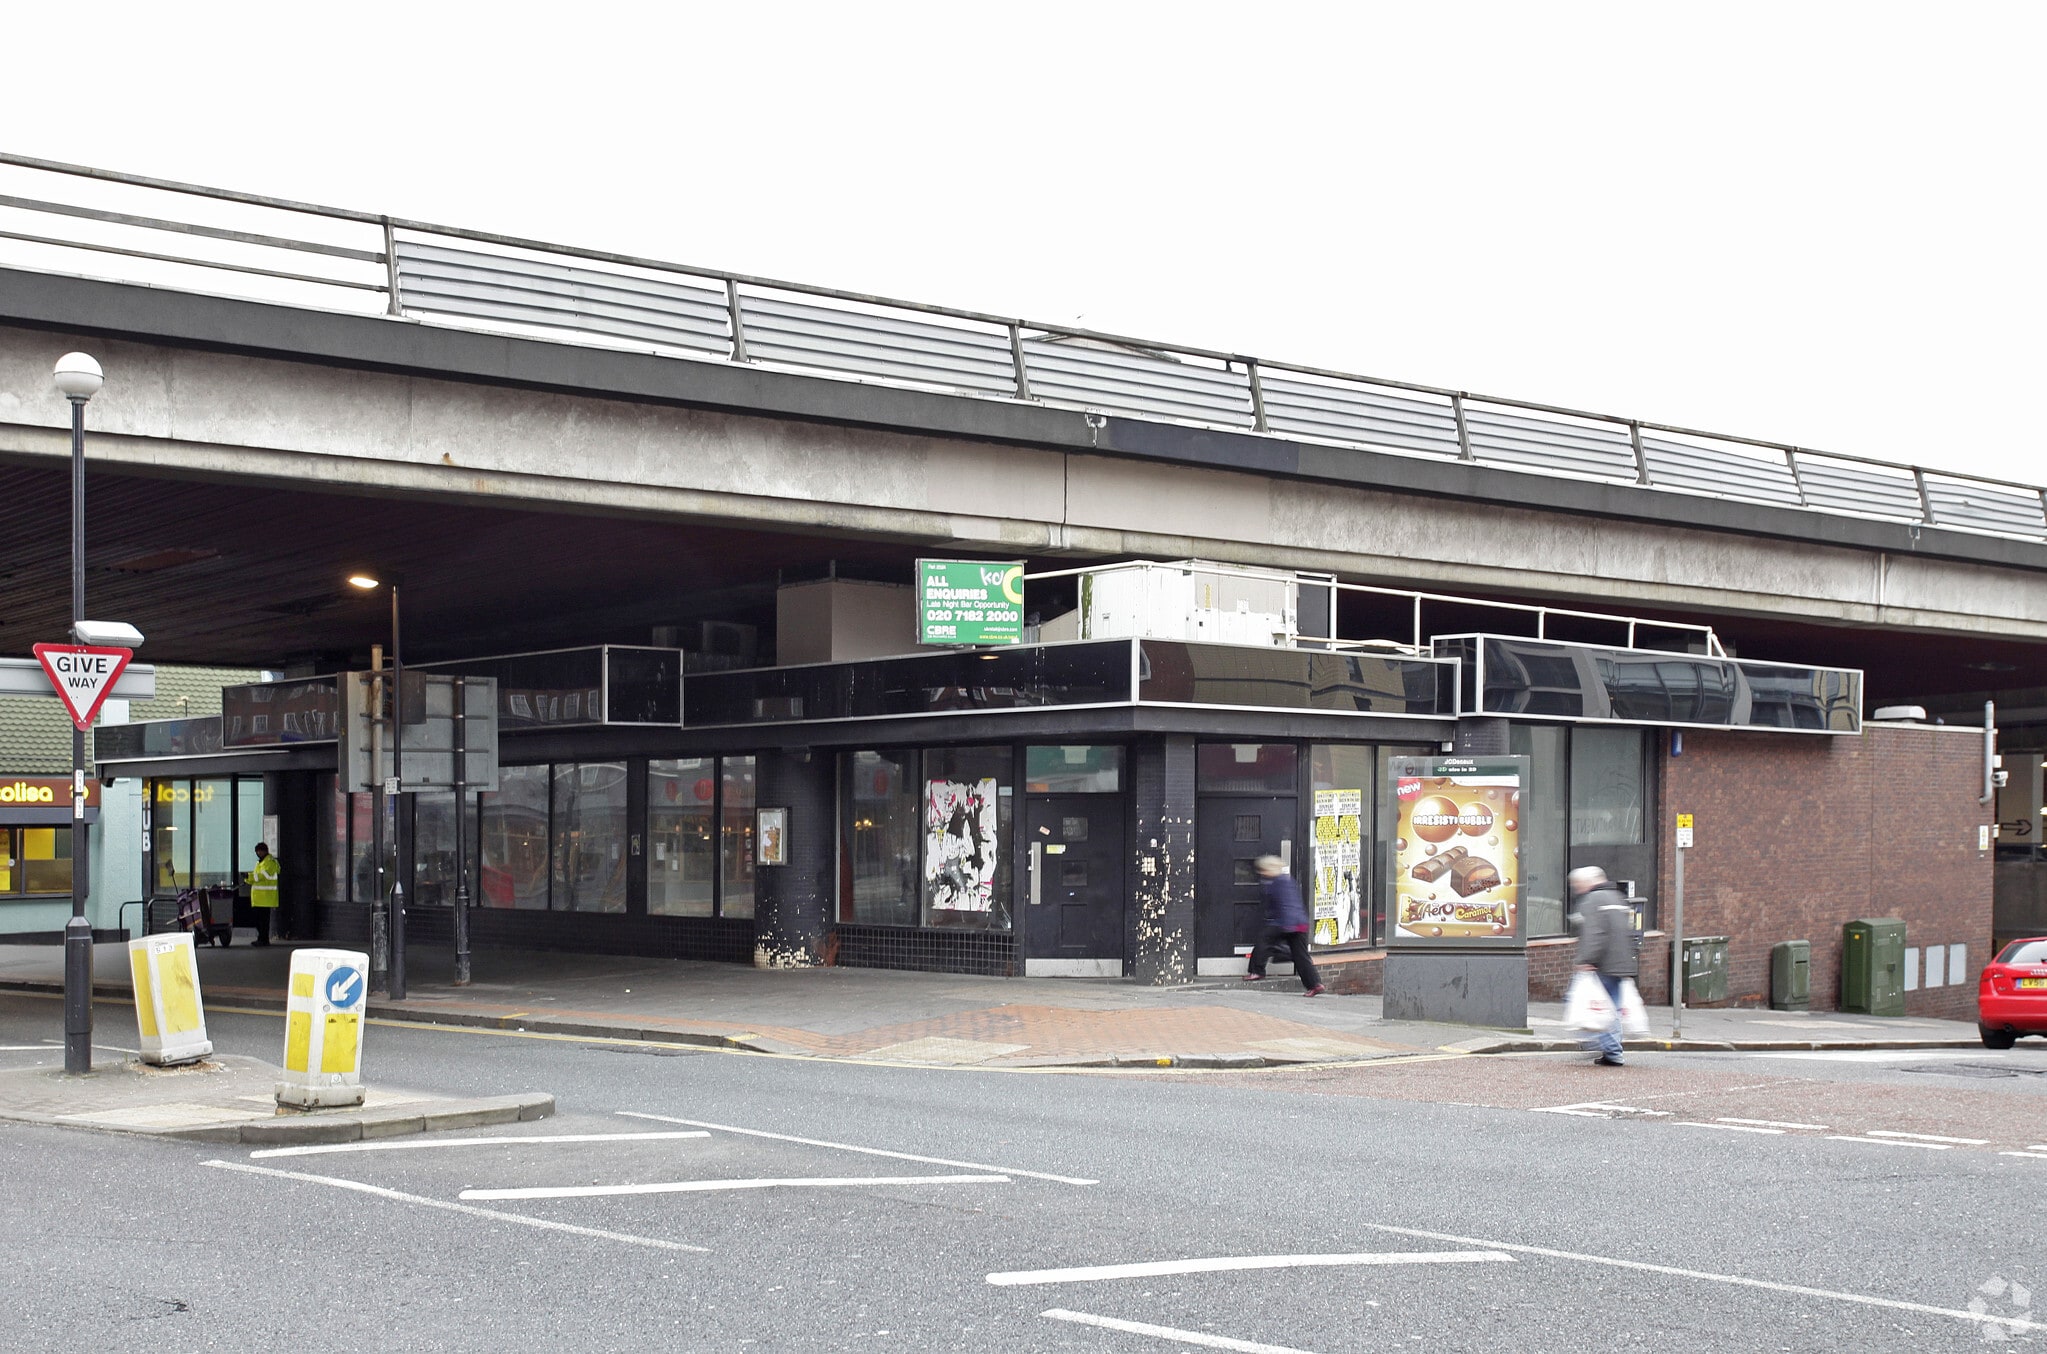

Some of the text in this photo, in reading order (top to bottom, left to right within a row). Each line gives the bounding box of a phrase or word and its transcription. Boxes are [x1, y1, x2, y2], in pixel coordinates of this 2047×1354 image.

[926, 575, 949, 587] ALL
[926, 588, 988, 600] ENQUIRIES
[926, 600, 1010, 611] Late Night Bar Opportunity
[926, 610, 1019, 622] 020 7182 2000
[926, 625, 957, 635] CBRE
[56, 656, 108, 674] GIVE
[68, 677, 98, 689] WAY
[0, 781, 54, 802] olisa
[1397, 781, 1421, 796] new
[1421, 902, 1492, 920] Aero Caramel
